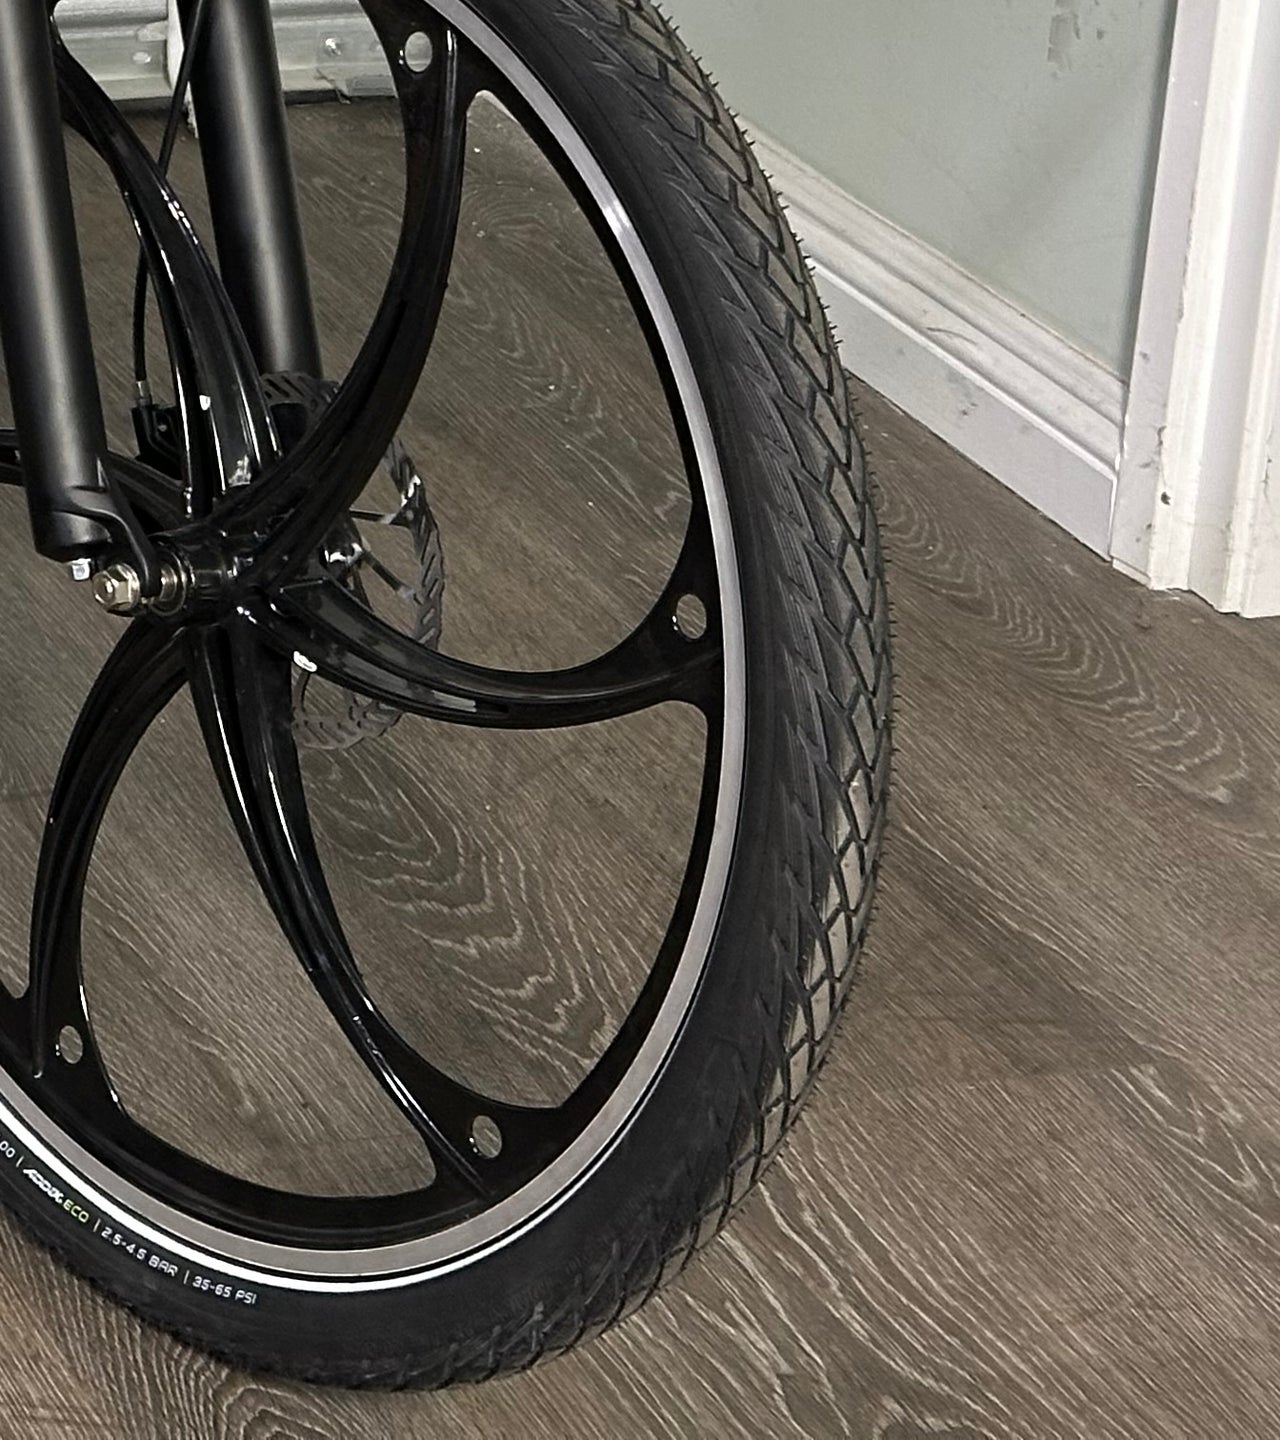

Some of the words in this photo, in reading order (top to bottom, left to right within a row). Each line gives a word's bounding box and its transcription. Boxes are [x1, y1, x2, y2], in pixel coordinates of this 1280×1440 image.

[63, 1199, 90, 1224] ECO
[101, 1227, 147, 1260] 2.5-4.5
[148, 1255, 178, 1277] BAR
[192, 1276, 233, 1298] 35-65
[235, 1290, 257, 1304] PSI
